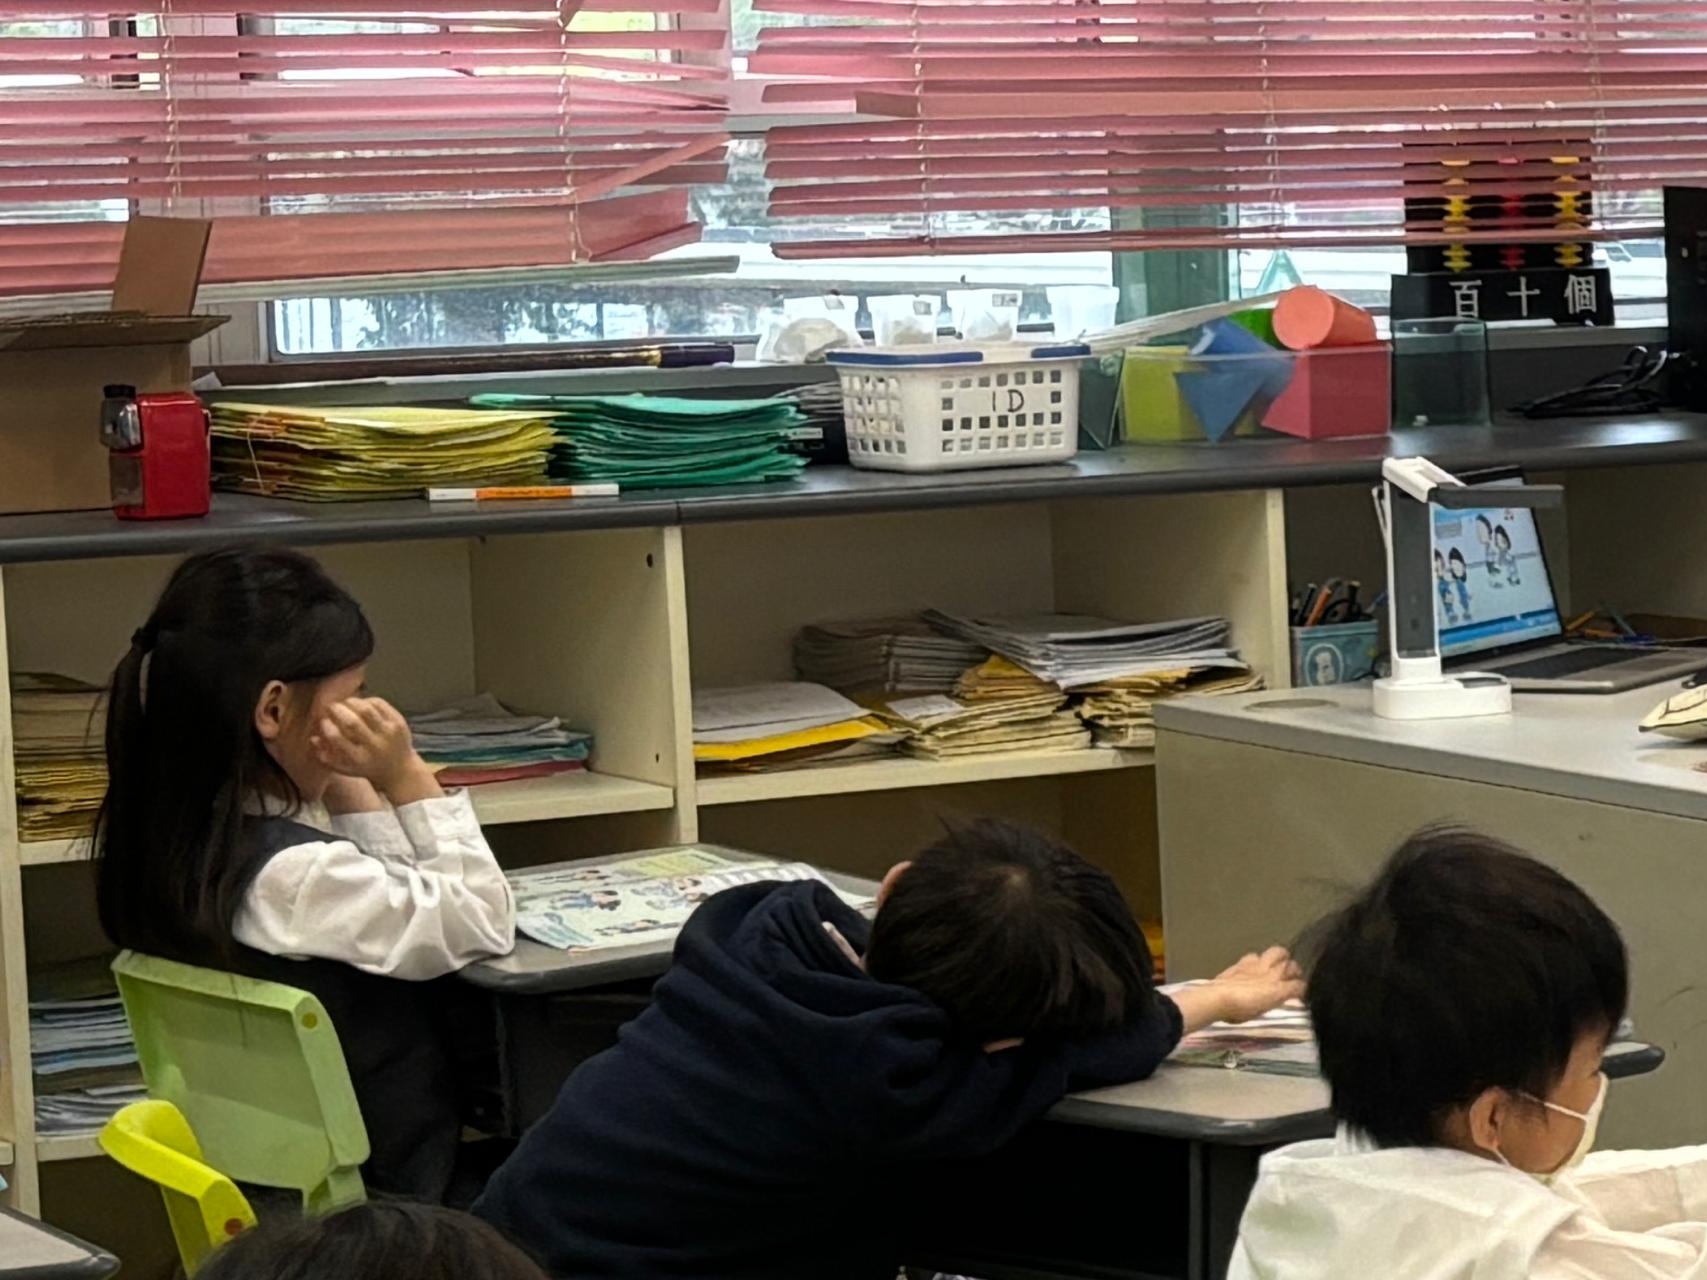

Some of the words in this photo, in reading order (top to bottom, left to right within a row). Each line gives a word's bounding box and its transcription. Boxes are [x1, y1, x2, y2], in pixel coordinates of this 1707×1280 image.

[1449, 280, 1482, 318] 百
[1506, 276, 1541, 317] 十
[1564, 274, 1597, 314] 個
